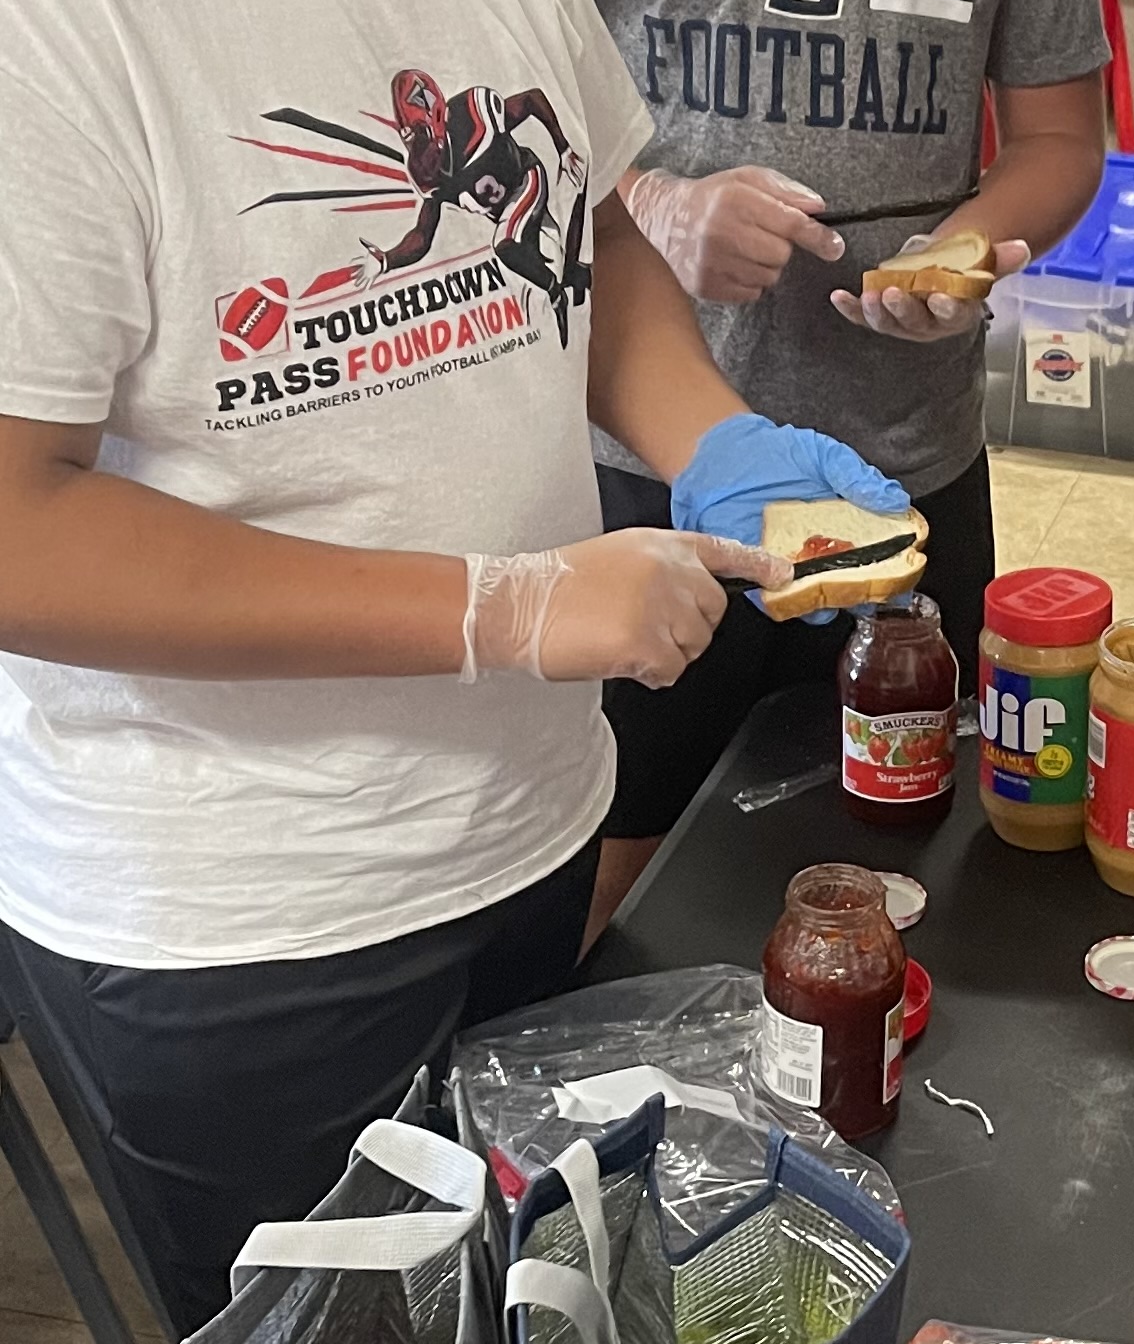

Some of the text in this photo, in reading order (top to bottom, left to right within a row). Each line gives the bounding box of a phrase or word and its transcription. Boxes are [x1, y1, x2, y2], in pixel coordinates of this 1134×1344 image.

[643, 14, 948, 135] FOOTBALL
[294, 258, 507, 350] TOUCHDOWN
[204, 409, 283, 432] TACKLING
[286, 389, 361, 418] BARRIERS
[363, 383, 384, 400] TO
[386, 370, 431, 393] YOUTH
[430, 350, 490, 379] FOOTBALL
[215, 356, 341, 412] PASS
[979, 683, 1067, 753] Jif
[876, 770, 938, 784] Strawberry
